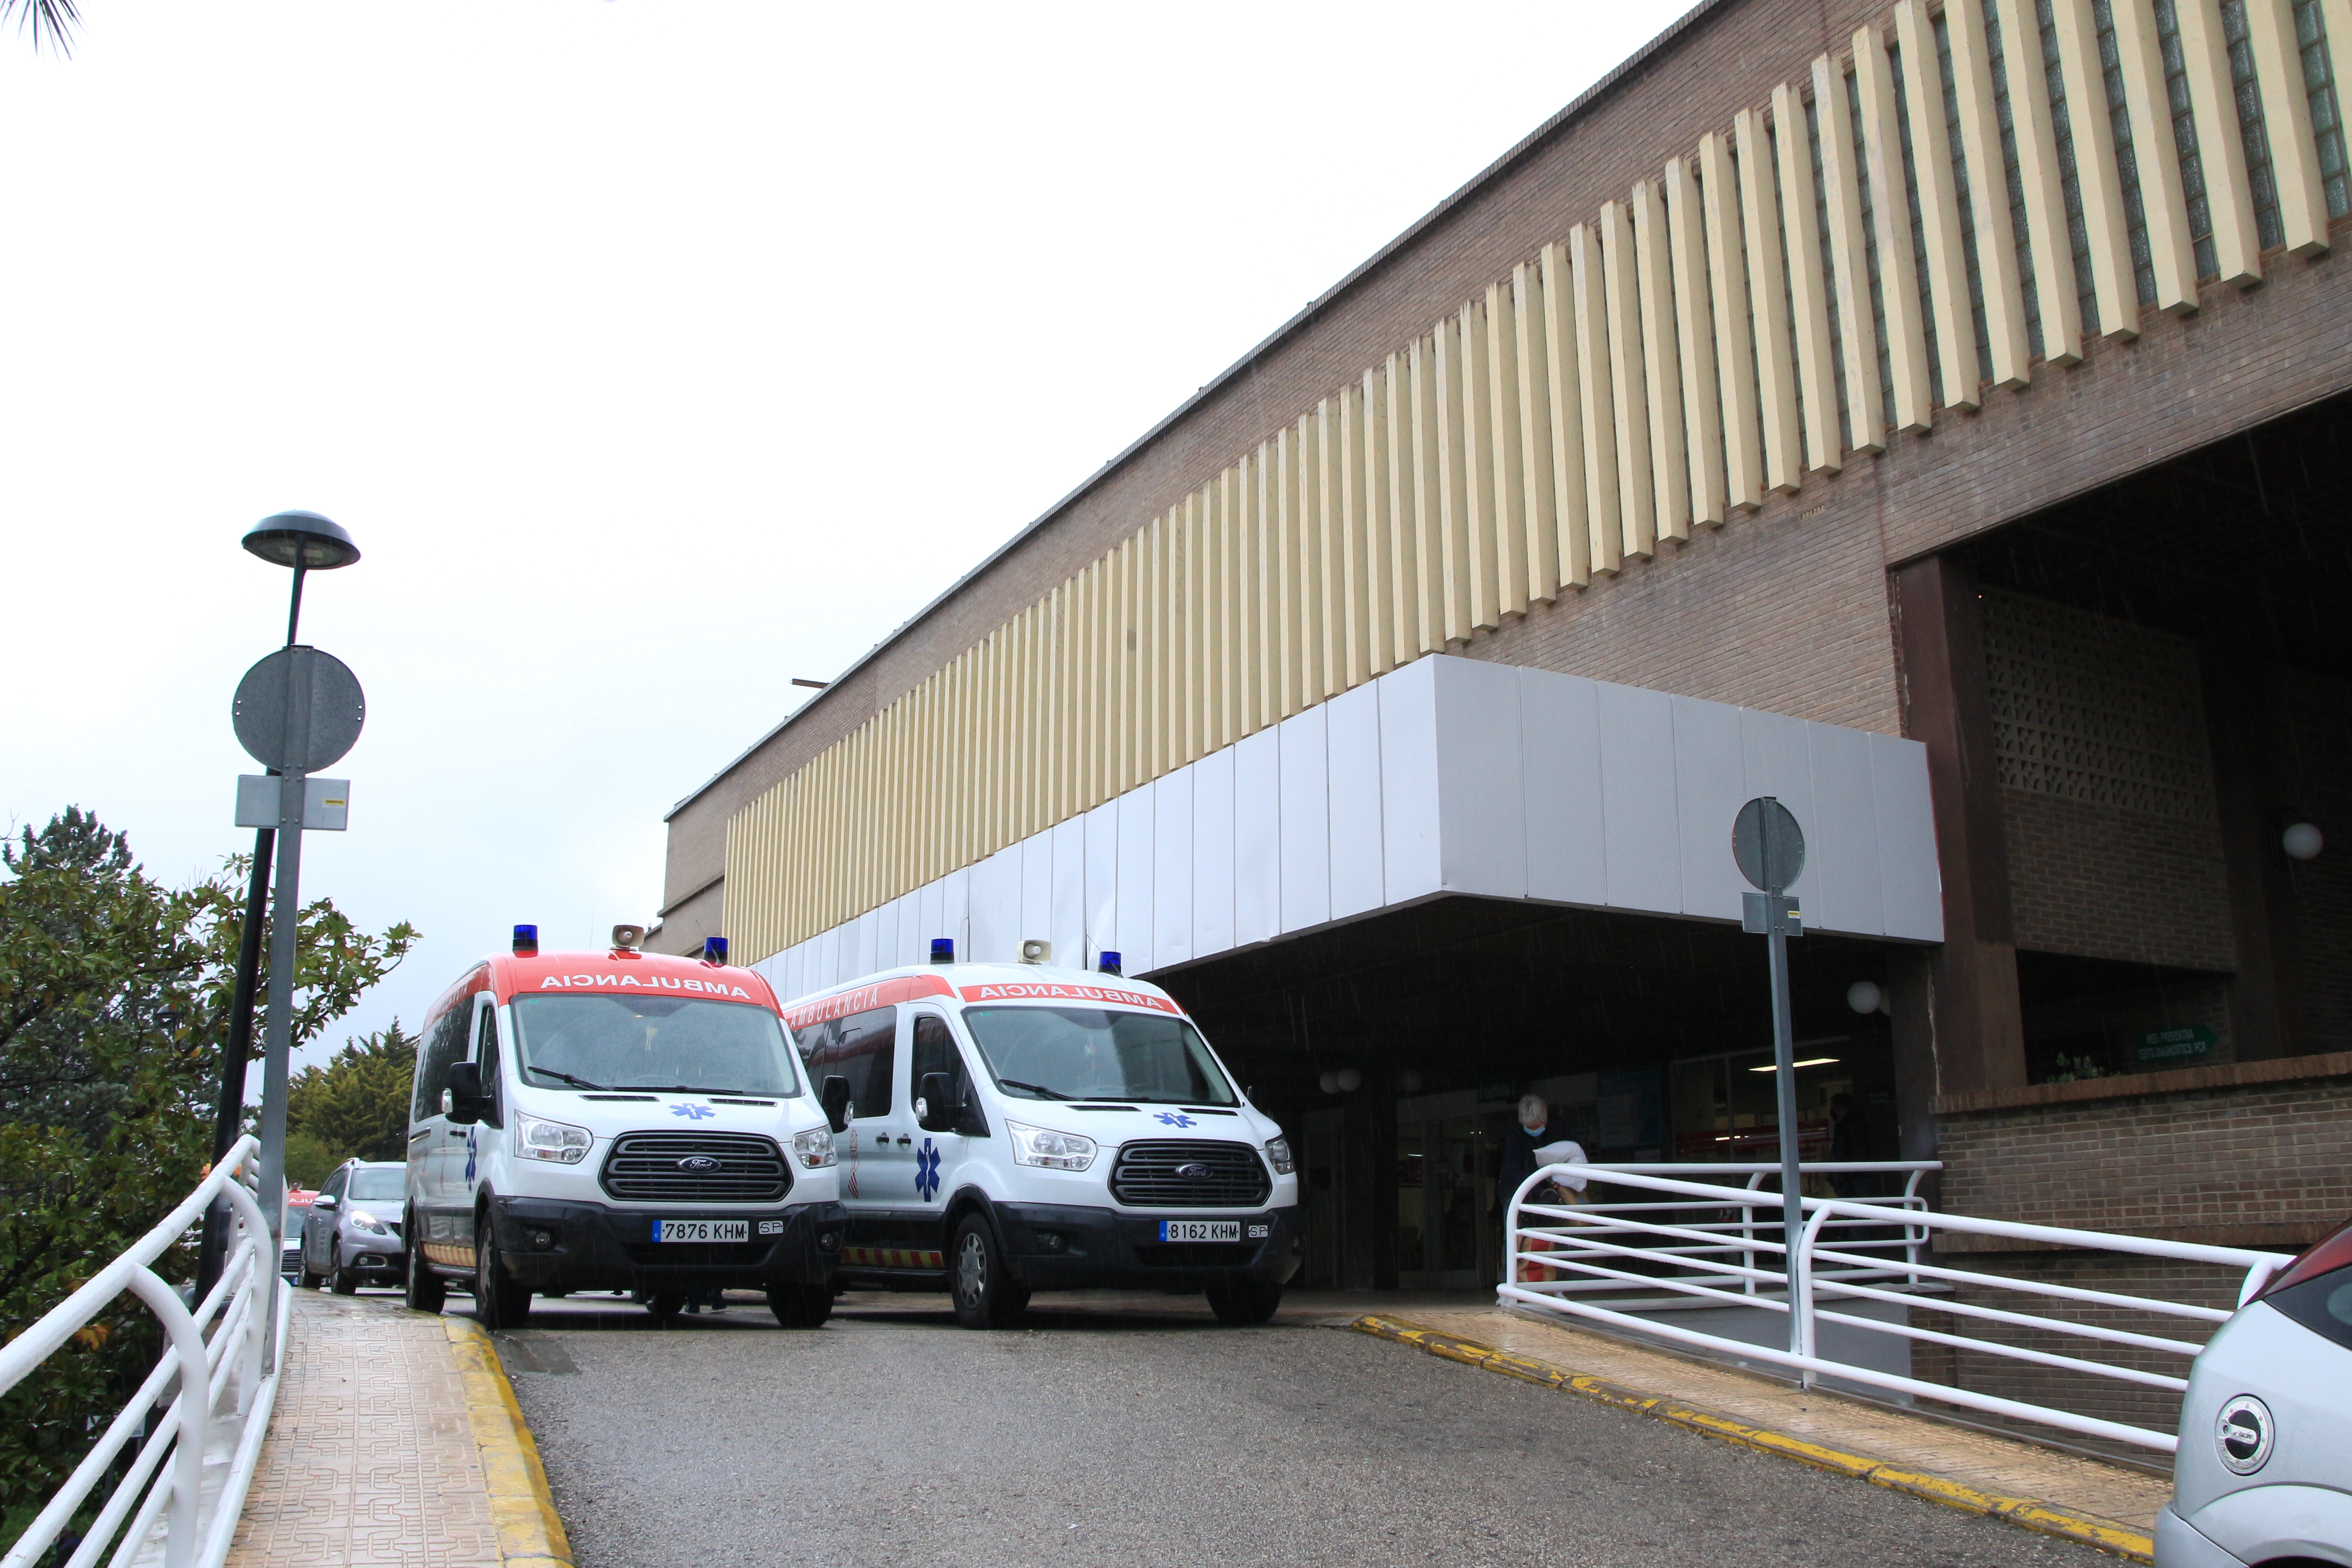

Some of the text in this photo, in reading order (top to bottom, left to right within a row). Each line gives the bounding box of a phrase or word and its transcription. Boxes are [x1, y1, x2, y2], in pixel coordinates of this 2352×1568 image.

[789, 986, 878, 1029] AMBULANCIA
[2138, 1048, 2155, 1059] TESTS
[2194, 1041, 2206, 1053] PCR
[689, 1159, 712, 1169] Ford
[1187, 1166, 1206, 1176] Ford
[665, 1223, 745, 1239] 7876 KHM
[760, 1222, 781, 1233] SP
[1170, 1224, 1237, 1239] 8162 KHM
[1250, 1226, 1266, 1236] SP
